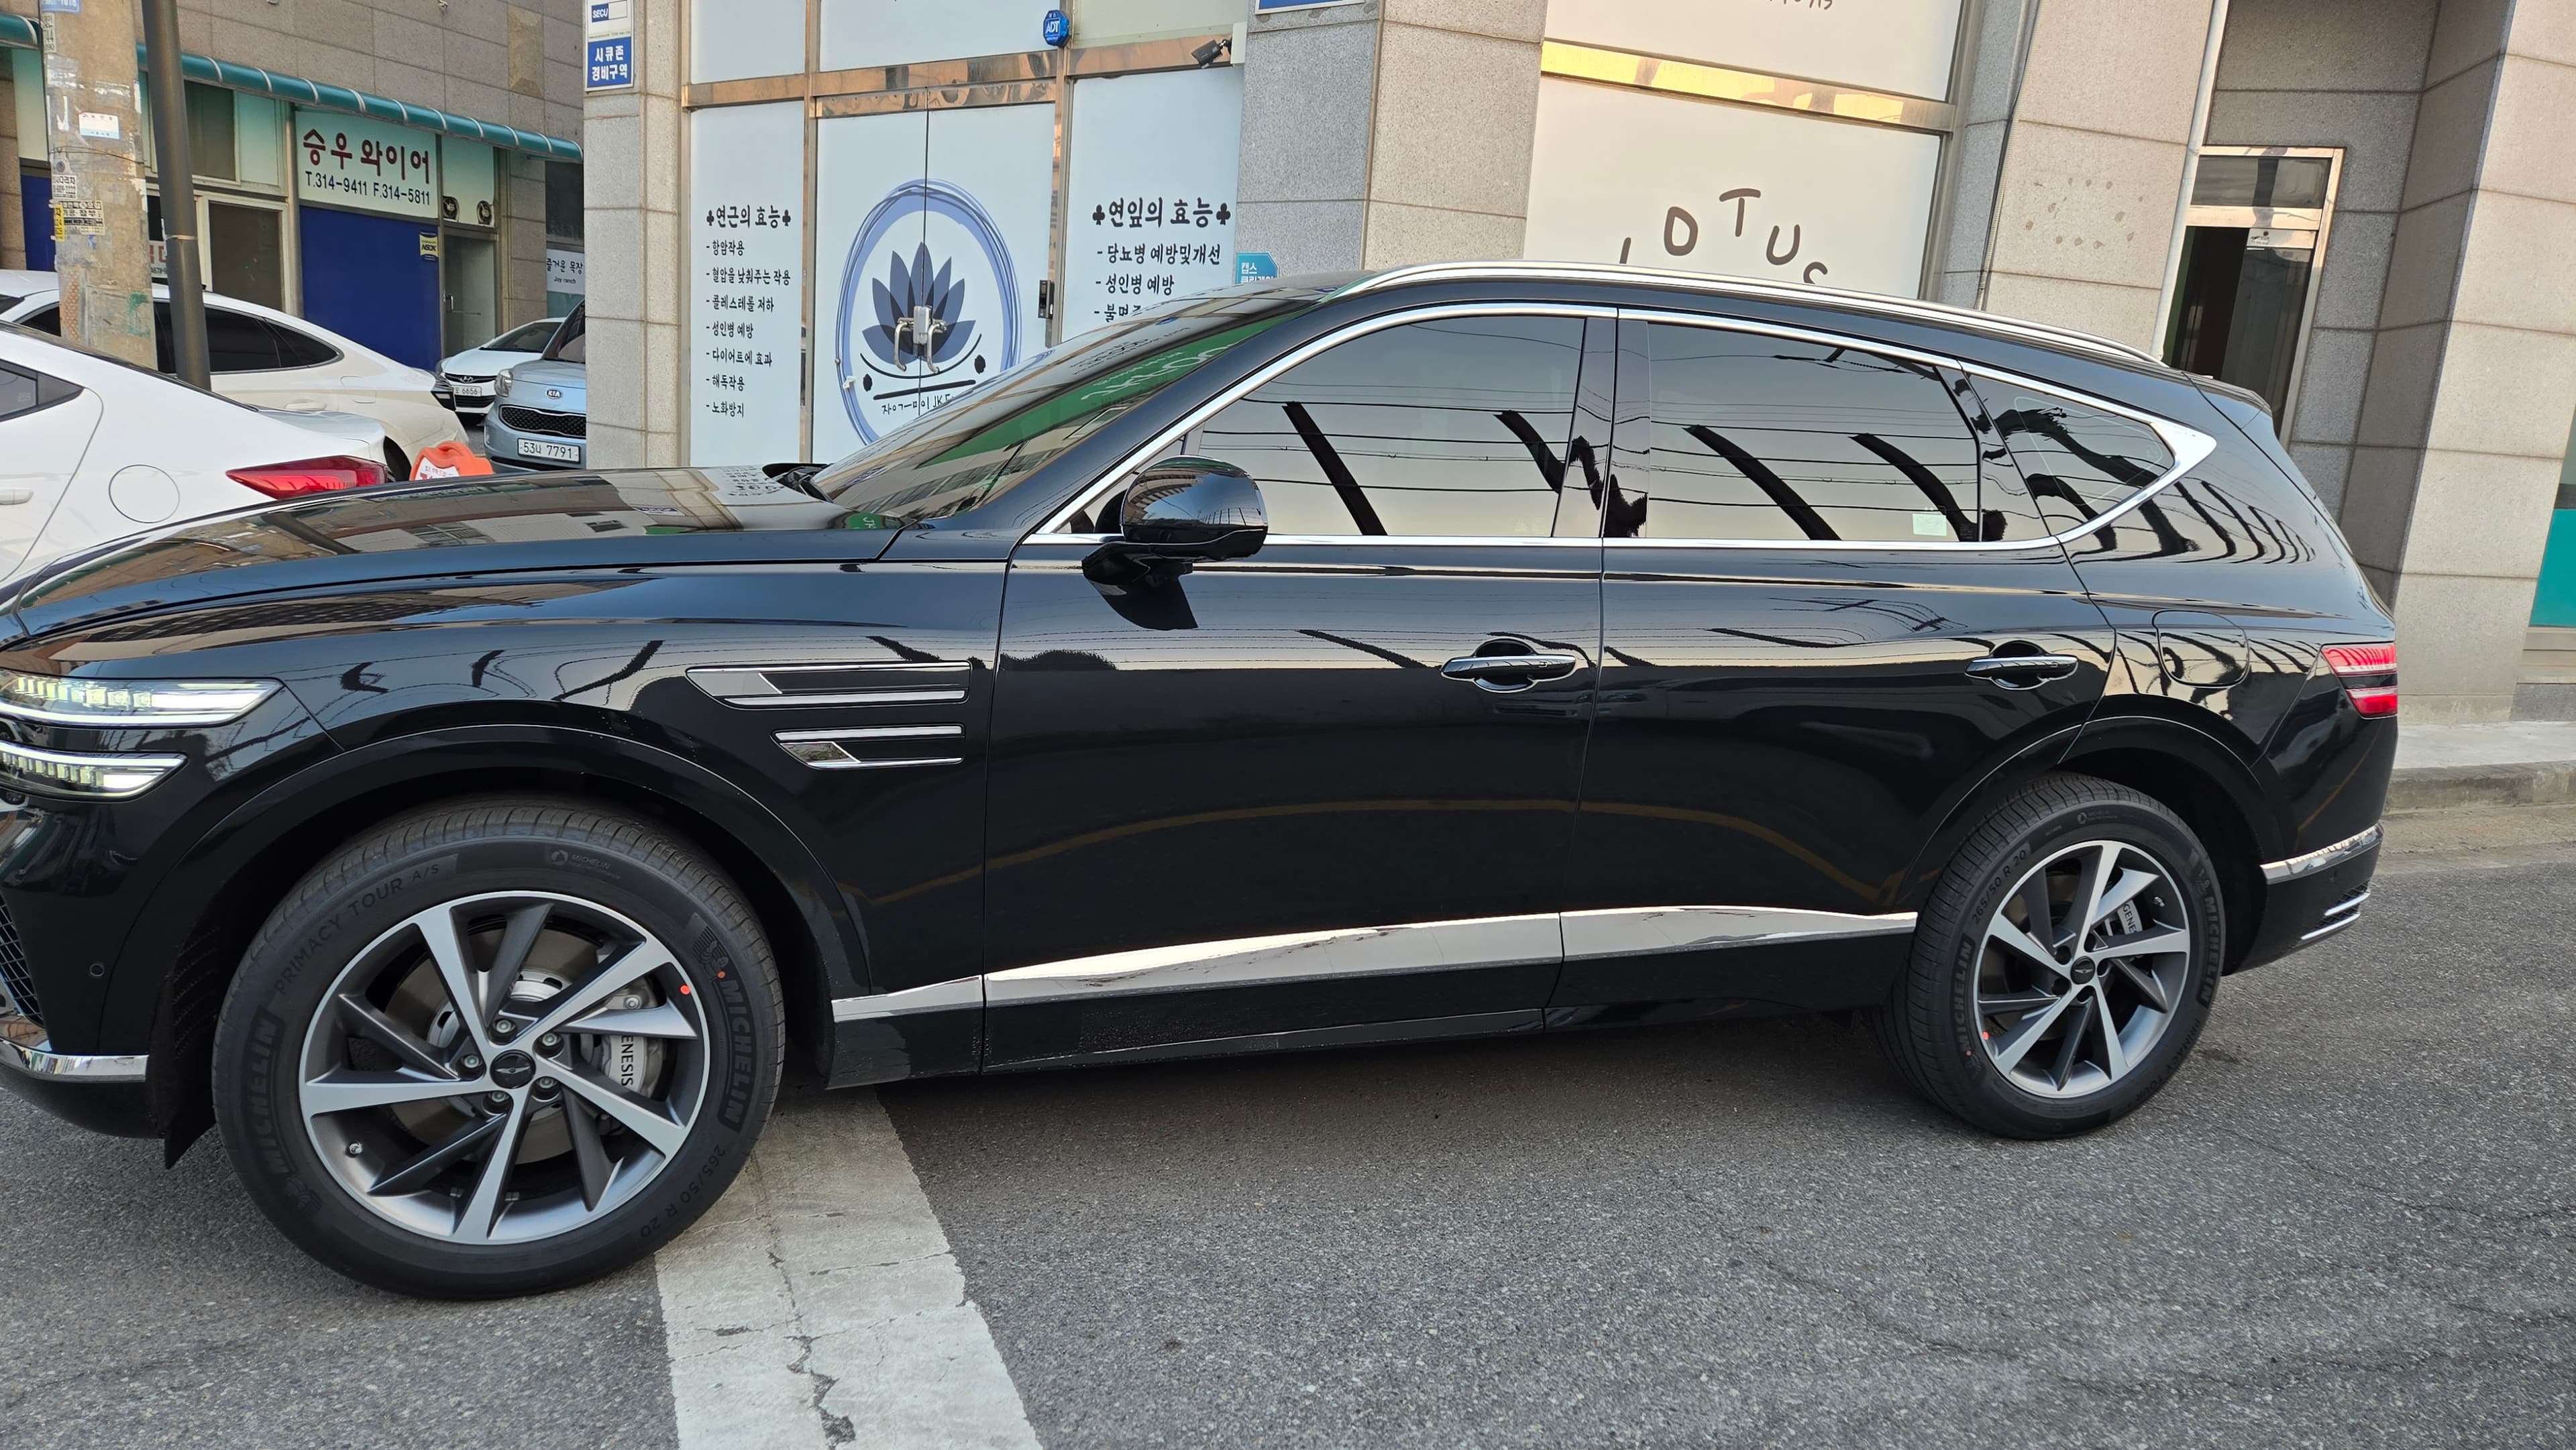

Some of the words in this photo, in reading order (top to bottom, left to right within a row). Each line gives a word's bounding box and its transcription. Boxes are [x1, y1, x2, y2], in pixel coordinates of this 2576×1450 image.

[1045, 21, 1060, 34] ADT
[595, 45, 625, 62] 시큐존
[592, 63, 628, 81] 경비구역
[303, 128, 353, 170] 승우
[360, 139, 430, 184] 와이어
[305, 170, 368, 196] T.314-9411
[373, 182, 430, 206] F.314-5811
[716, 205, 750, 228] 연근의
[755, 205, 781, 229] 효능
[1109, 197, 1163, 228] 연잎의
[1170, 197, 1213, 228] 효능
[712, 239, 745, 256] 항암작용
[1108, 243, 1145, 264] 당뇨병
[547, 258, 566, 273] 즐거운
[570, 260, 584, 274] 목장
[1241, 262, 1257, 274] 캡스
[712, 267, 735, 284] 혈압을
[738, 267, 771, 284] 낮춰주는
[773, 268, 791, 286] 작용
[1106, 274, 1142, 294] 성인병
[1147, 274, 1175, 296] 예방
[757, 296, 774, 313] 저하
[712, 321, 735, 337] 성인병
[737, 322, 754, 339] 예방
[712, 347, 753, 366] 다이어트에
[755, 351, 772, 367] 효과
[712, 374, 745, 391] 해독작용
[547, 390, 561, 398] KIA
[712, 401, 744, 418] 노화방지
[547, 445, 572, 459] 7791
[1972, 875, 2002, 924] 265/50
[2002, 865, 2012, 878] R
[2013, 849, 2027, 867] 20
[273, 916, 342, 995] PRIMACY
[347, 878, 404, 917] TOUR
[411, 863, 440, 882] A/S
[2200, 896, 2219, 999] MICHELIN
[1953, 942, 1972, 1048] MICHELIN
[621, 1035, 633, 1086] ENESIS
[720, 979, 752, 1125] MICHELIN
[680, 1145, 726, 1204] 265/50
[665, 1204, 678, 1216] R
[641, 1218, 661, 1237] 20
